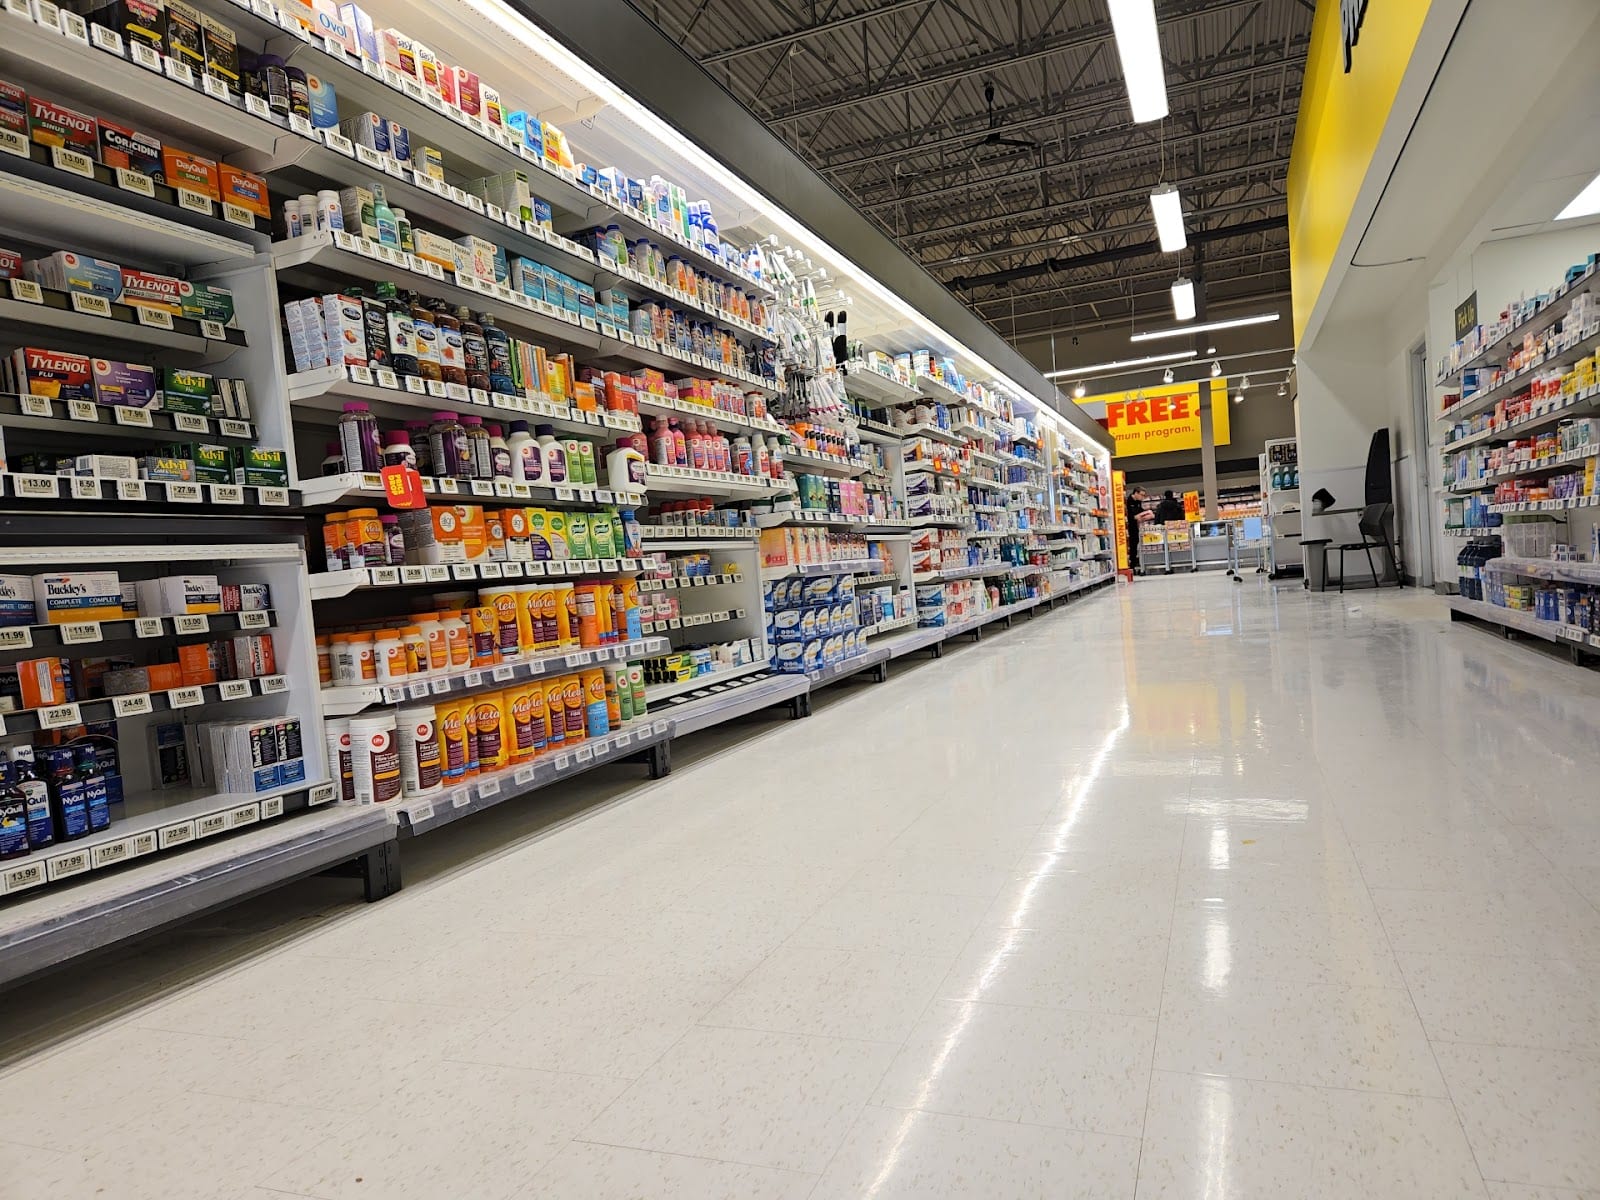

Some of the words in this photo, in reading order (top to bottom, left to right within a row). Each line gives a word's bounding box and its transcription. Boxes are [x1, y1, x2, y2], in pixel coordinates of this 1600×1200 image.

[319, 13, 347, 38] Ovol
[33, 103, 92, 134] TYLENOL
[41, 122, 65, 133] SINUS
[105, 130, 159, 158] CORICIDIN
[62, 153, 85, 166] 13.00
[176, 159, 208, 177] DayQuil
[126, 174, 146, 186] 12.00
[231, 175, 259, 191] DayQuil
[124, 275, 177, 294] TYLENOL
[84, 297, 105, 307] 10.00
[30, 354, 87, 374] TYLENOL
[38, 372, 54, 380] FLU
[174, 375, 206, 389] Advil
[1145, 426, 1195, 440] program.
[199, 450, 225, 462] Advil
[252, 450, 281, 462] Advil
[155, 459, 188, 470] Advil
[28, 479, 52, 488] 13.00
[388, 475, 399, 496] DROP
[394, 473, 405, 495] PRICE
[48, 584, 87, 597] Buckley's
[49, 598, 82, 606] COMPLETE
[1, 631, 24, 640] 11.99
[74, 625, 95, 634] 11.99
[49, 709, 72, 718] 22.99
[168, 827, 188, 839] 22.99
[102, 845, 123, 858] 17.99
[58, 856, 82, 868] 17.99
[12, 868, 37, 881] 13.99
